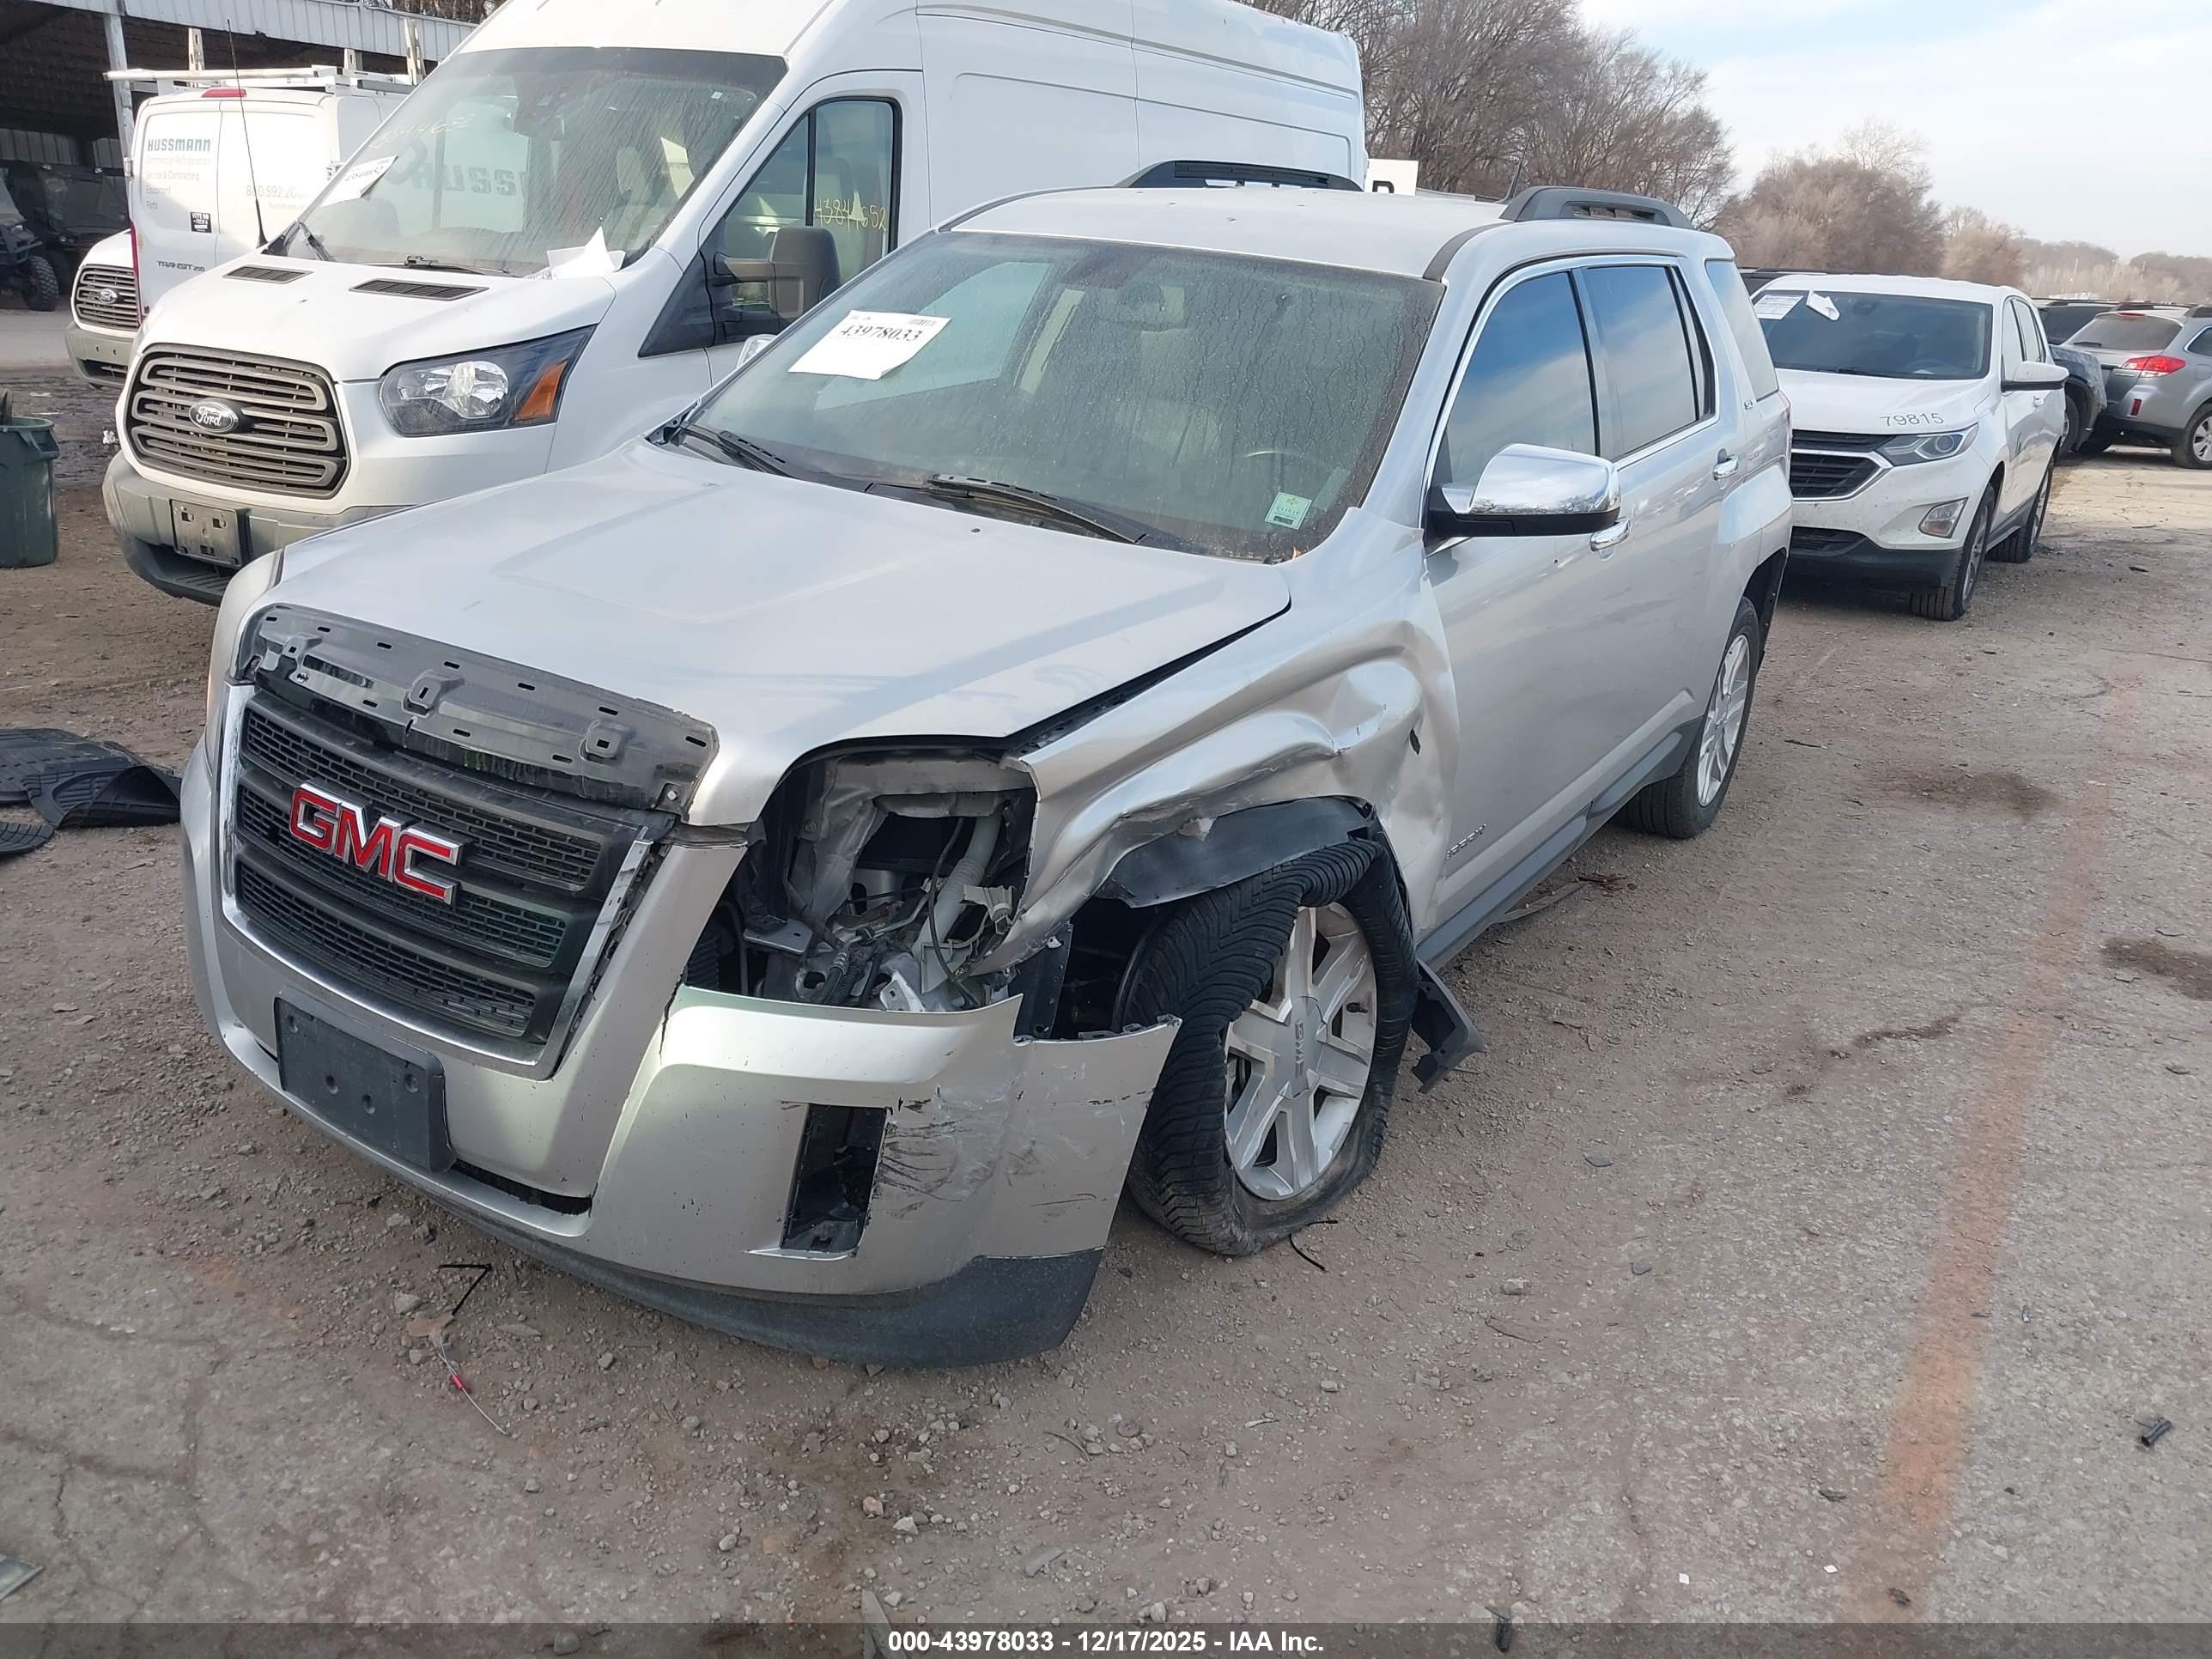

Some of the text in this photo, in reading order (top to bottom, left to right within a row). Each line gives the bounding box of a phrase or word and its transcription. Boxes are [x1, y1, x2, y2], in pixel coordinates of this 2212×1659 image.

[148, 138, 210, 151] HUSSMANN
[156, 260, 192, 270] TRANSIT
[841, 325, 923, 342] 43978033
[196, 405, 222, 427] Ford
[1879, 413, 1944, 426] 79815
[290, 783, 459, 905] GMC
